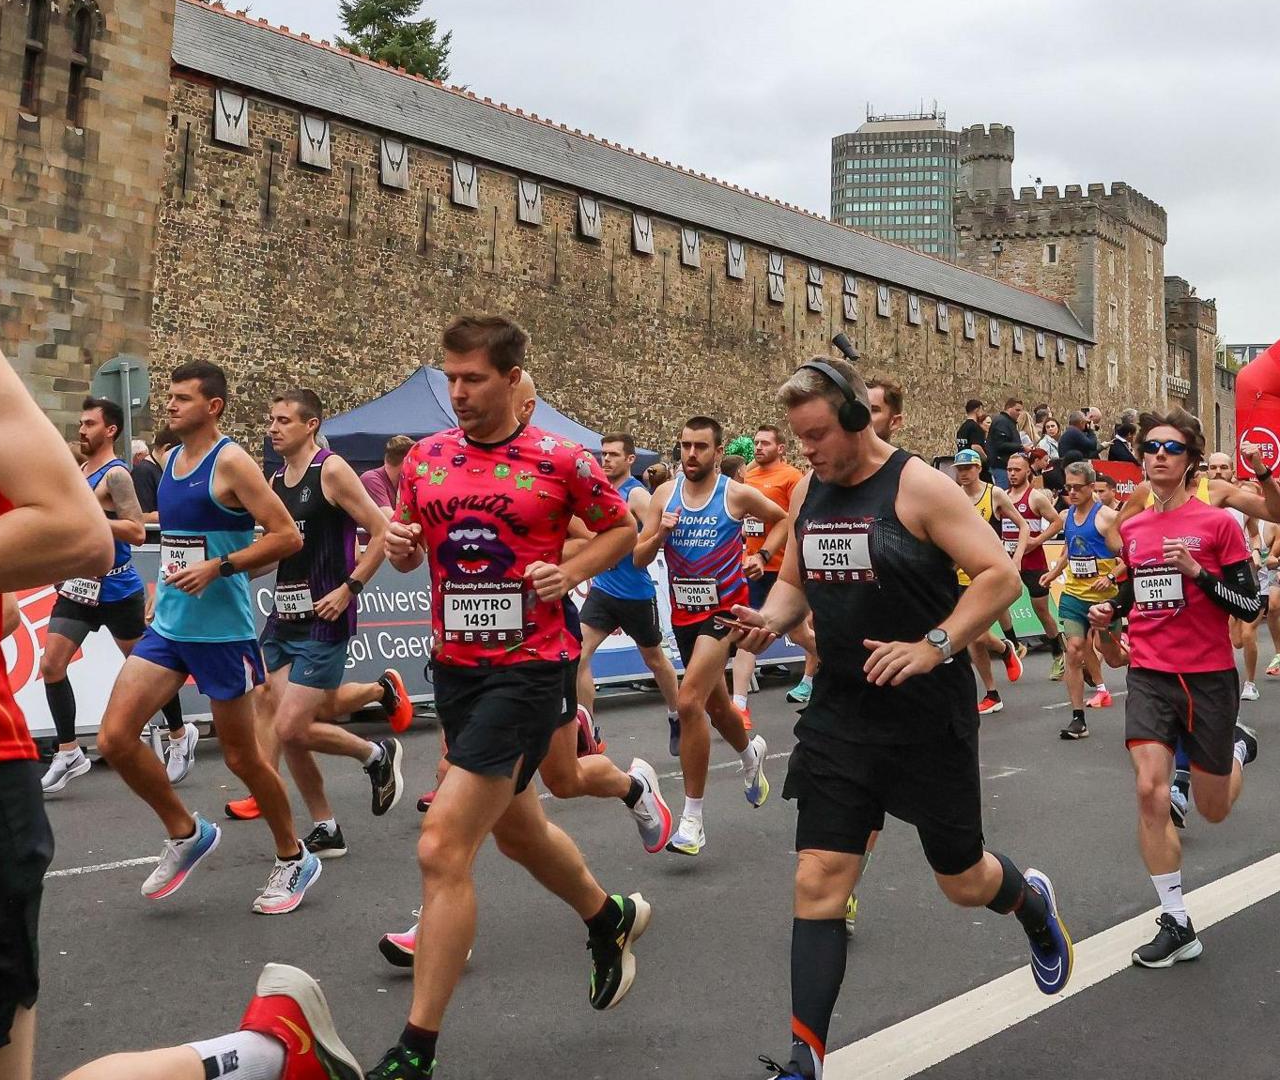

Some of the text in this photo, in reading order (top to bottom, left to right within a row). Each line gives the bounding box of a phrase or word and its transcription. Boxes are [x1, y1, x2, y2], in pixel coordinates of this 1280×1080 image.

[1256, 443, 1273, 451] PER
[678, 516, 718, 525] HOMAS
[688, 529, 718, 537] HARD
[672, 539, 716, 547] HARRIERS
[818, 538, 852, 550] MARK
[170, 550, 185, 559] RAY
[822, 553, 849, 566] 2541
[1141, 578, 1172, 588] CIARAN
[71, 586, 88, 595] 1859
[678, 586, 710, 594] THOMAS
[1149, 589, 1163, 599] 511
[276, 593, 305, 601] MICHAEL
[357, 585, 433, 614] niversi
[452, 599, 511, 610] DMYTRO
[464, 613, 496, 626] 1491
